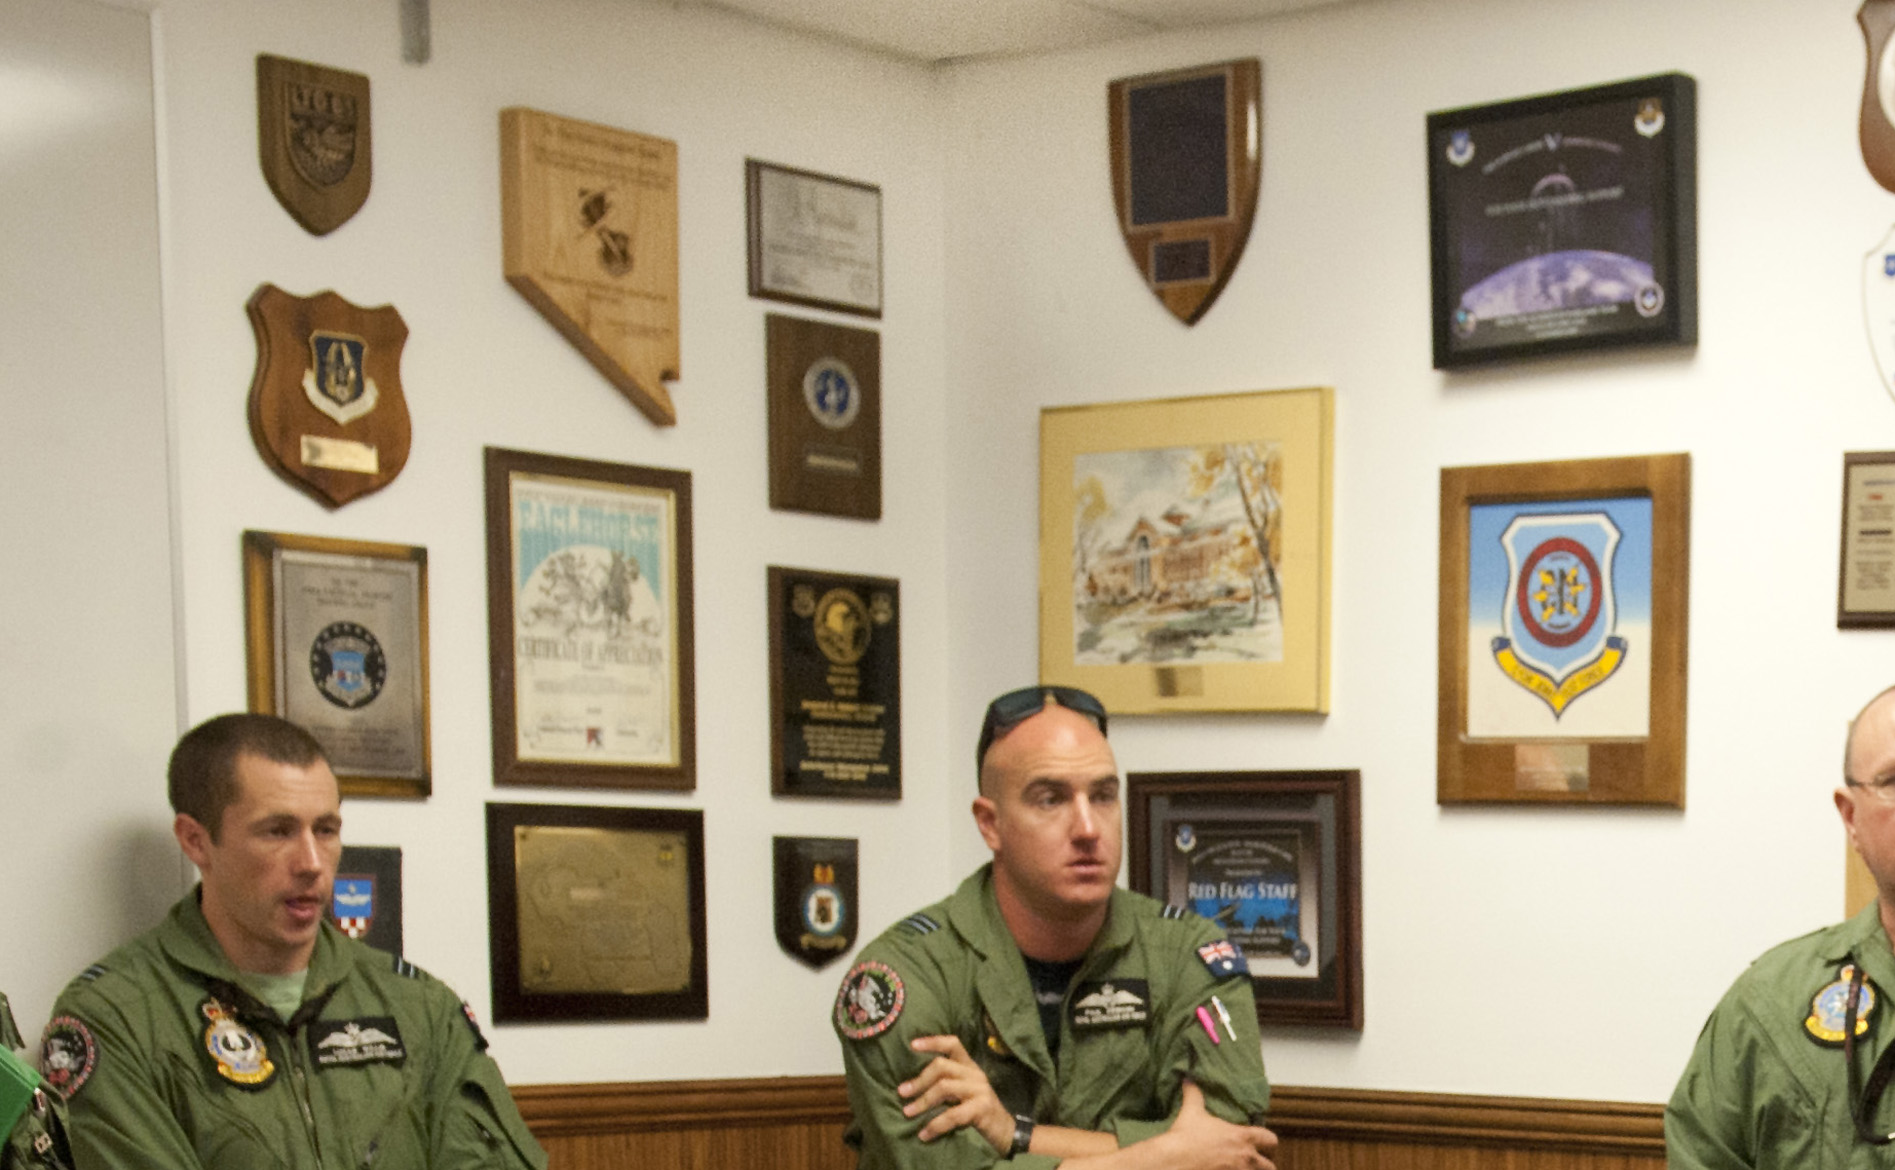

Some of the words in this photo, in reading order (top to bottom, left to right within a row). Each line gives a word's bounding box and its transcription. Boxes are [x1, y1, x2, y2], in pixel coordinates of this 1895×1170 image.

[1188, 881, 1218, 900] RED
[1219, 881, 1255, 900] FLAG
[1257, 881, 1297, 900] STAFF
